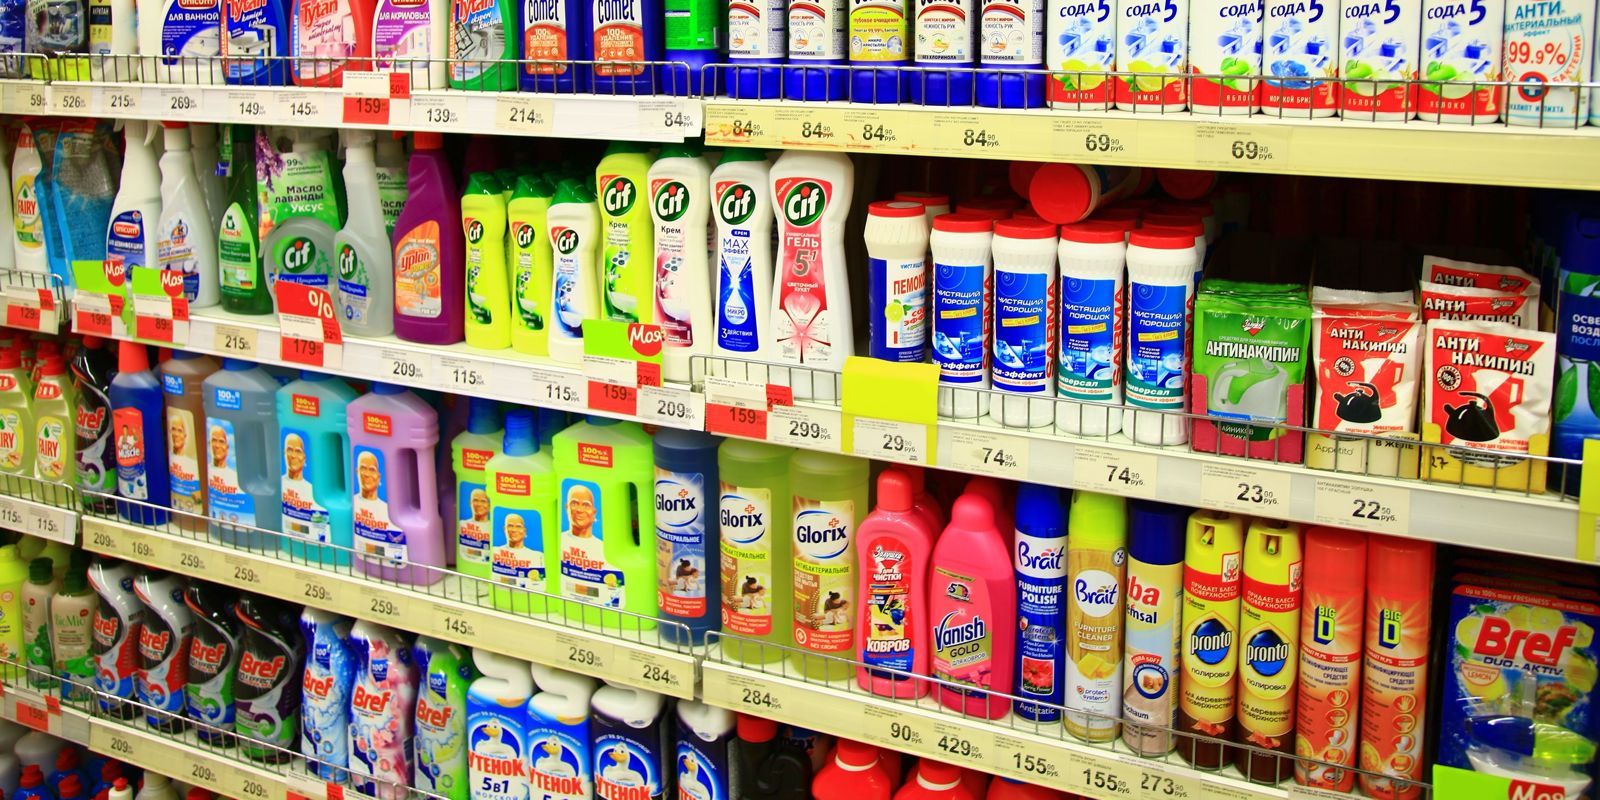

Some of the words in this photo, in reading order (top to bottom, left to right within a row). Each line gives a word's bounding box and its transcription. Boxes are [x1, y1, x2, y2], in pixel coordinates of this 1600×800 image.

[168, 14, 183, 22] ДЛЯ
[185, 11, 219, 21] ВАННОЙ
[391, 12, 430, 20] АКРИЛОВЫХ
[1060, 3, 1094, 18] СОДА
[1097, 0, 1110, 22] 5
[1126, 3, 1160, 18] СОДА
[1164, 0, 1177, 22] 5
[1220, 3, 1255, 19] СОДА
[1270, 3, 1306, 17] СОДА
[1308, 0, 1324, 23] 5
[1345, 3, 1380, 18] СОДА
[1384, 0, 1400, 24] 5
[1428, 4, 1466, 20] СОДА
[1469, 0, 1486, 26] 5
[1509, 42, 1566, 65] 99.9%
[62, 96, 81, 108] 526
[111, 95, 130, 107] 215
[171, 96, 190, 110] 269
[239, 102, 259, 115] 149
[356, 98, 381, 113] 159
[290, 103, 311, 116] 145
[427, 108, 450, 123] 139
[510, 108, 535, 123] 214
[664, 112, 684, 127] 84
[733, 121, 753, 136] 84
[802, 122, 822, 138] 84
[863, 125, 884, 140] 84
[964, 130, 987, 146] 84
[1086, 134, 1110, 151] 69
[1232, 141, 1258, 159] 69
[286, 184, 323, 194] Масло
[606, 180, 631, 211] Cif
[274, 193, 324, 204] лаванды
[657, 186, 684, 216] Cif
[722, 188, 751, 219] Cif
[786, 186, 820, 220] Cif
[18, 200, 36, 215] FAIRY
[291, 203, 324, 214] Уксус
[114, 225, 138, 234] unicum
[468, 224, 482, 241] Cif
[609, 221, 628, 229] Крем
[661, 225, 681, 234] Крем
[518, 228, 533, 246] Cif
[558, 232, 576, 251] Cif
[786, 237, 819, 247] ГЕЛЬ
[285, 240, 310, 268] Cif
[340, 247, 355, 273] Cif
[402, 250, 430, 271] yplon
[937, 290, 980, 298] ЧИСТЯЩИЙ
[942, 297, 980, 305] ПОРОШОК
[998, 296, 1043, 306] ЧИСТЯЩИЙ
[308, 290, 333, 319] %
[1003, 305, 1043, 313] ПОРОШОК
[1064, 303, 1110, 312] ЧИСТЯЩИЙ
[1424, 297, 1466, 311] АНТИ
[91, 314, 106, 325] 199
[1069, 312, 1110, 320] ПОРОШОК
[1134, 310, 1182, 320] ЧИСТЯЩИЙ
[156, 318, 166, 330] 89
[1139, 320, 1182, 328] ПОРОШОК
[727, 329, 752, 337] ДЕЙСТВИЯ
[1112, 287, 1122, 386] SARMA
[1330, 328, 1364, 339] АНТИ
[225, 335, 245, 349] 215
[294, 339, 316, 355] 179
[1342, 340, 1406, 354] НАКИПИН
[1436, 336, 1480, 351] АНТИ
[1206, 341, 1300, 362] АНТИНАКИПИН
[393, 361, 416, 377] 209
[1452, 352, 1535, 375] НАКИПИН
[453, 369, 476, 384] 115
[547, 384, 571, 400] 115
[603, 384, 627, 400] 159
[657, 400, 685, 418] 209
[729, 409, 756, 424] 159
[790, 420, 820, 438] 299
[39, 437, 58, 458] FAIRY
[883, 434, 903, 451] 29
[119, 448, 140, 458] Muscle
[982, 447, 1004, 466] 74
[1107, 465, 1130, 485] 74
[283, 494, 312, 509] Proper
[1237, 483, 1263, 504] 23
[656, 493, 696, 512] Glorix
[1352, 499, 1381, 520] 22
[2, 510, 17, 521] 115
[355, 514, 388, 531] Proper
[721, 510, 762, 528] Glorix
[38, 518, 54, 531] 115
[94, 533, 111, 546] 209
[797, 525, 846, 544] Glorix
[132, 543, 149, 555] 169
[1019, 541, 1064, 570] Brait
[180, 553, 199, 568] 259
[493, 554, 531, 567] Proper
[562, 552, 604, 570] Proper
[234, 566, 254, 582] 259
[873, 572, 902, 581] ЧИСТКИ
[305, 584, 326, 600] 259
[1018, 581, 1062, 594] FURNITURE
[1075, 579, 1117, 606] Brait
[1191, 582, 1218, 593] ПРИДАЕТ
[1022, 591, 1057, 605] POLISH
[1247, 597, 1295, 609] ПОВЕРХНОСТЯМ
[1248, 590, 1274, 602] ПРИДАЕТ
[1275, 596, 1294, 604] БЛЕСК
[1513, 595, 1549, 606] FRESHNESS
[371, 599, 393, 614] 259
[1319, 606, 1336, 617] BIG
[1383, 608, 1402, 621] BIG
[445, 617, 467, 634] 145
[1075, 621, 1116, 632] FURNITURE
[1317, 616, 1335, 640] D
[1383, 620, 1401, 645] D
[140, 624, 170, 651] Bref
[935, 616, 986, 652] Vanish
[1077, 632, 1112, 641] CLEANER
[1474, 616, 1578, 666] Bref
[190, 637, 227, 663] Bref
[866, 639, 910, 652] КОВРОВ
[950, 643, 980, 656] GOLD
[1191, 630, 1232, 655] pronto
[569, 647, 594, 665] 259
[1246, 643, 1289, 665] pronto
[240, 652, 286, 678] Bref
[1192, 668, 1230, 678] полировка
[643, 665, 670, 683] 284
[303, 668, 334, 697] Bref
[1246, 678, 1286, 690] полировка
[353, 684, 392, 712] Bref
[742, 688, 771, 708] 284
[417, 698, 451, 728] Bref
[891, 722, 911, 741] 90
[111, 738, 129, 753] 209
[938, 735, 970, 757] 429
[468, 751, 525, 777] УТЕНОК
[1013, 752, 1047, 774] 155
[193, 765, 210, 780] 209
[1083, 768, 1118, 791] 155
[244, 780, 263, 796] 209
[529, 767, 584, 796] УТЕНОК
[1141, 773, 1174, 794] 273
